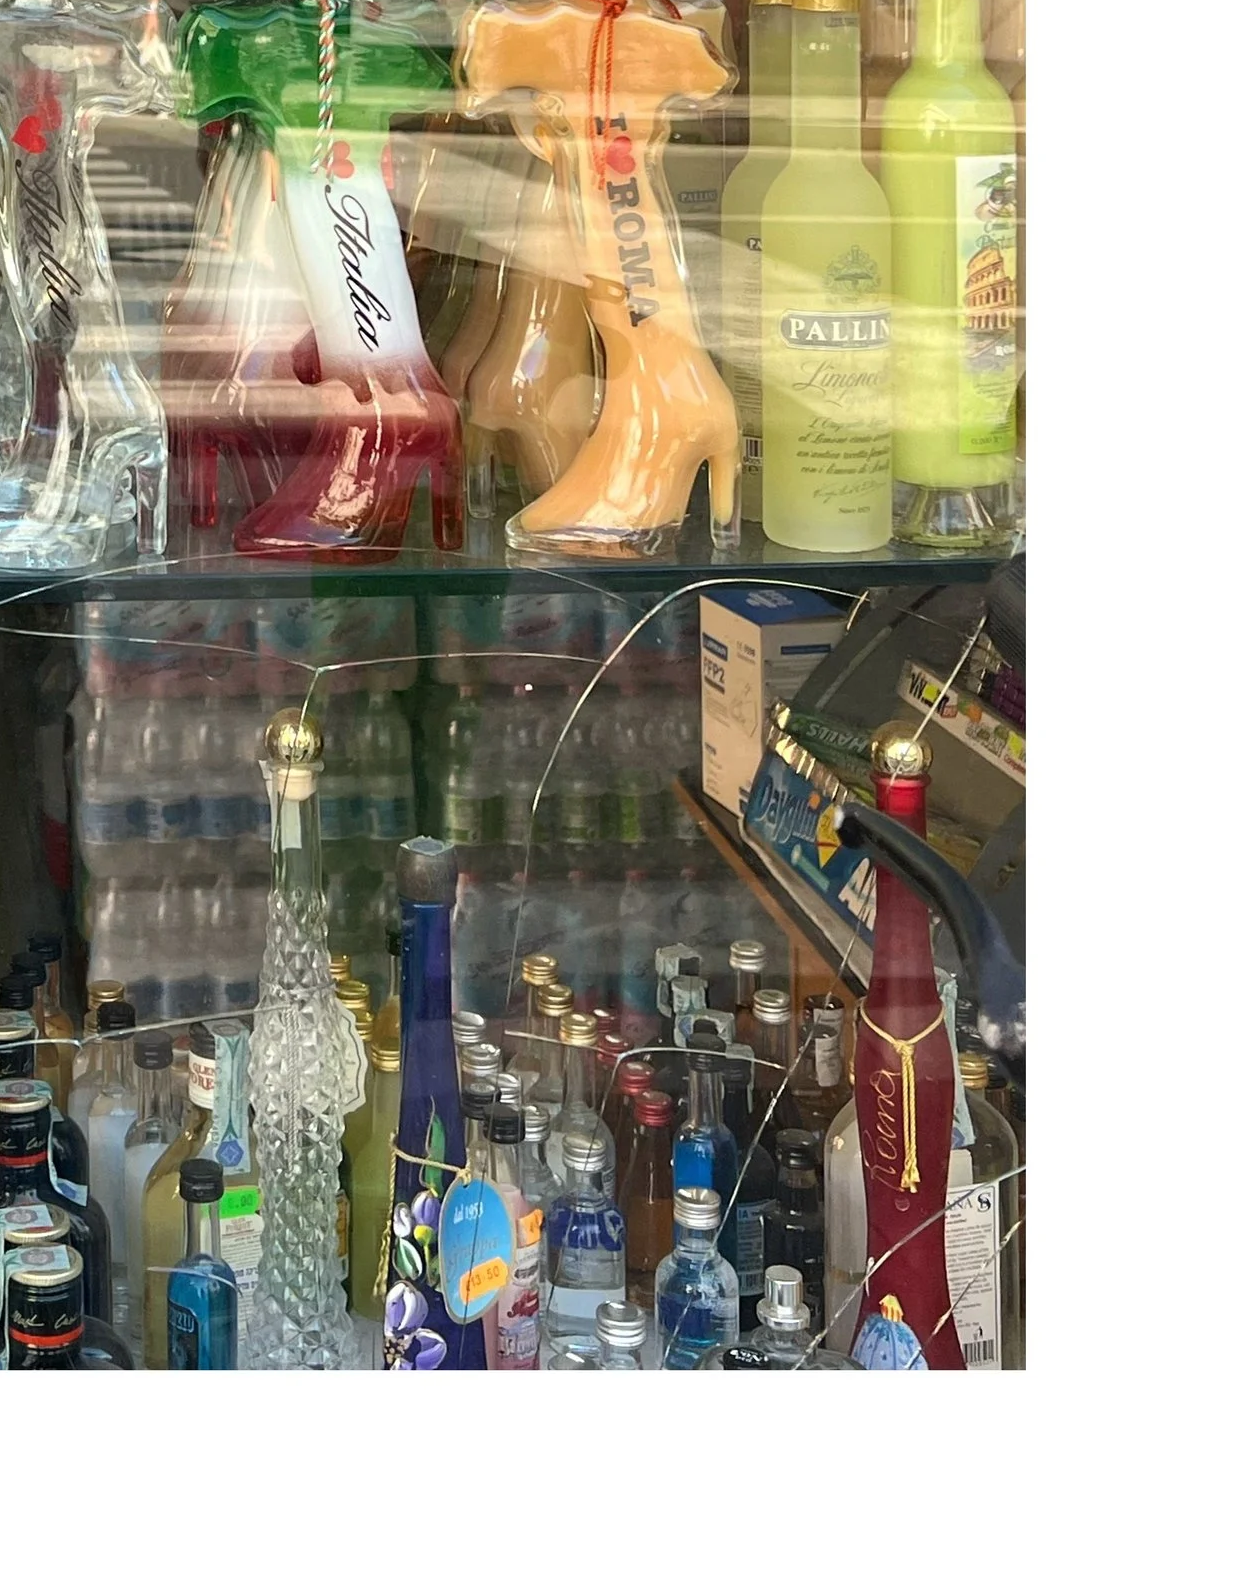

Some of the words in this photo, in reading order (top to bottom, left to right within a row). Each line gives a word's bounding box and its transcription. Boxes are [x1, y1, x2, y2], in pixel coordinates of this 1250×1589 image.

[324, 185, 392, 352] Italia
[607, 177, 660, 328] ROMA
[789, 317, 890, 341] PALLIN
[806, 724, 868, 753] HALLS
